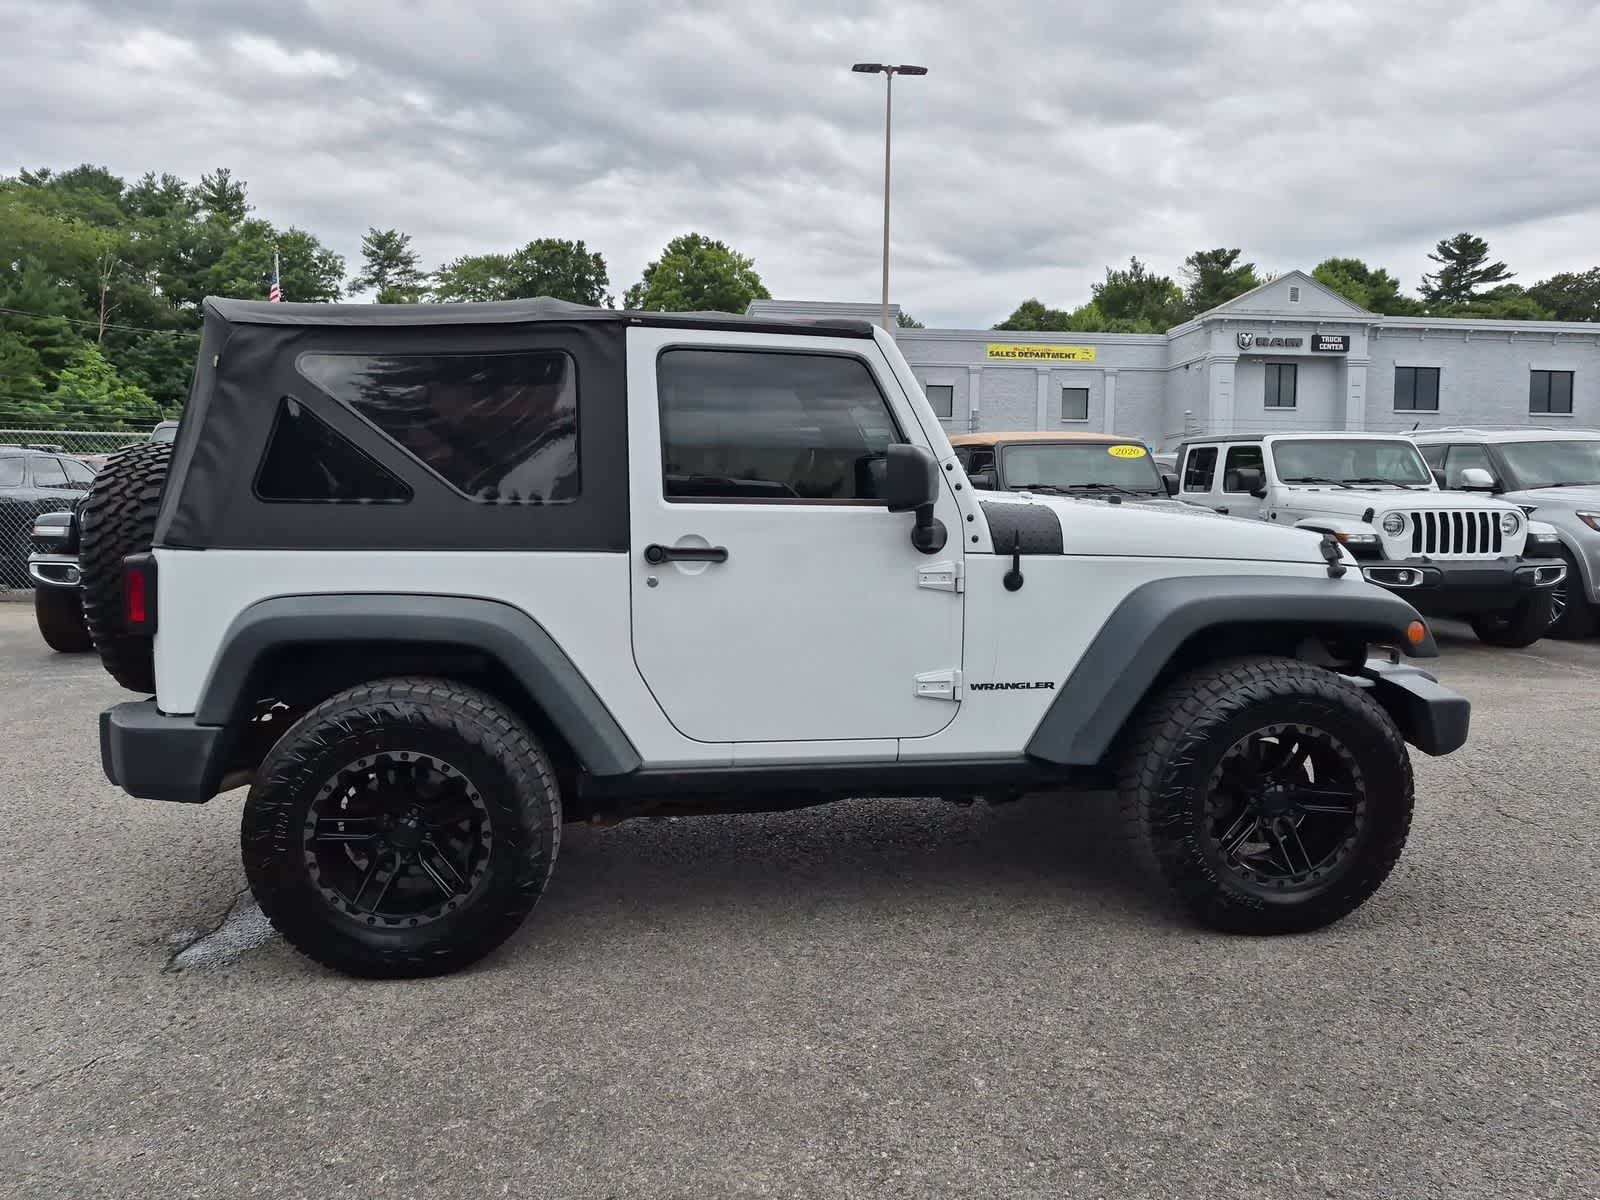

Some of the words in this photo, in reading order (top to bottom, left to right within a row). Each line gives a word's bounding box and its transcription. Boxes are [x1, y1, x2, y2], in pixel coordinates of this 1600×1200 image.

[1255, 337, 1303, 348] RAM
[989, 350, 1017, 358] SALES
[1018, 351, 1077, 360] DEPARTMENT
[970, 681, 1056, 691] WRANGLER
